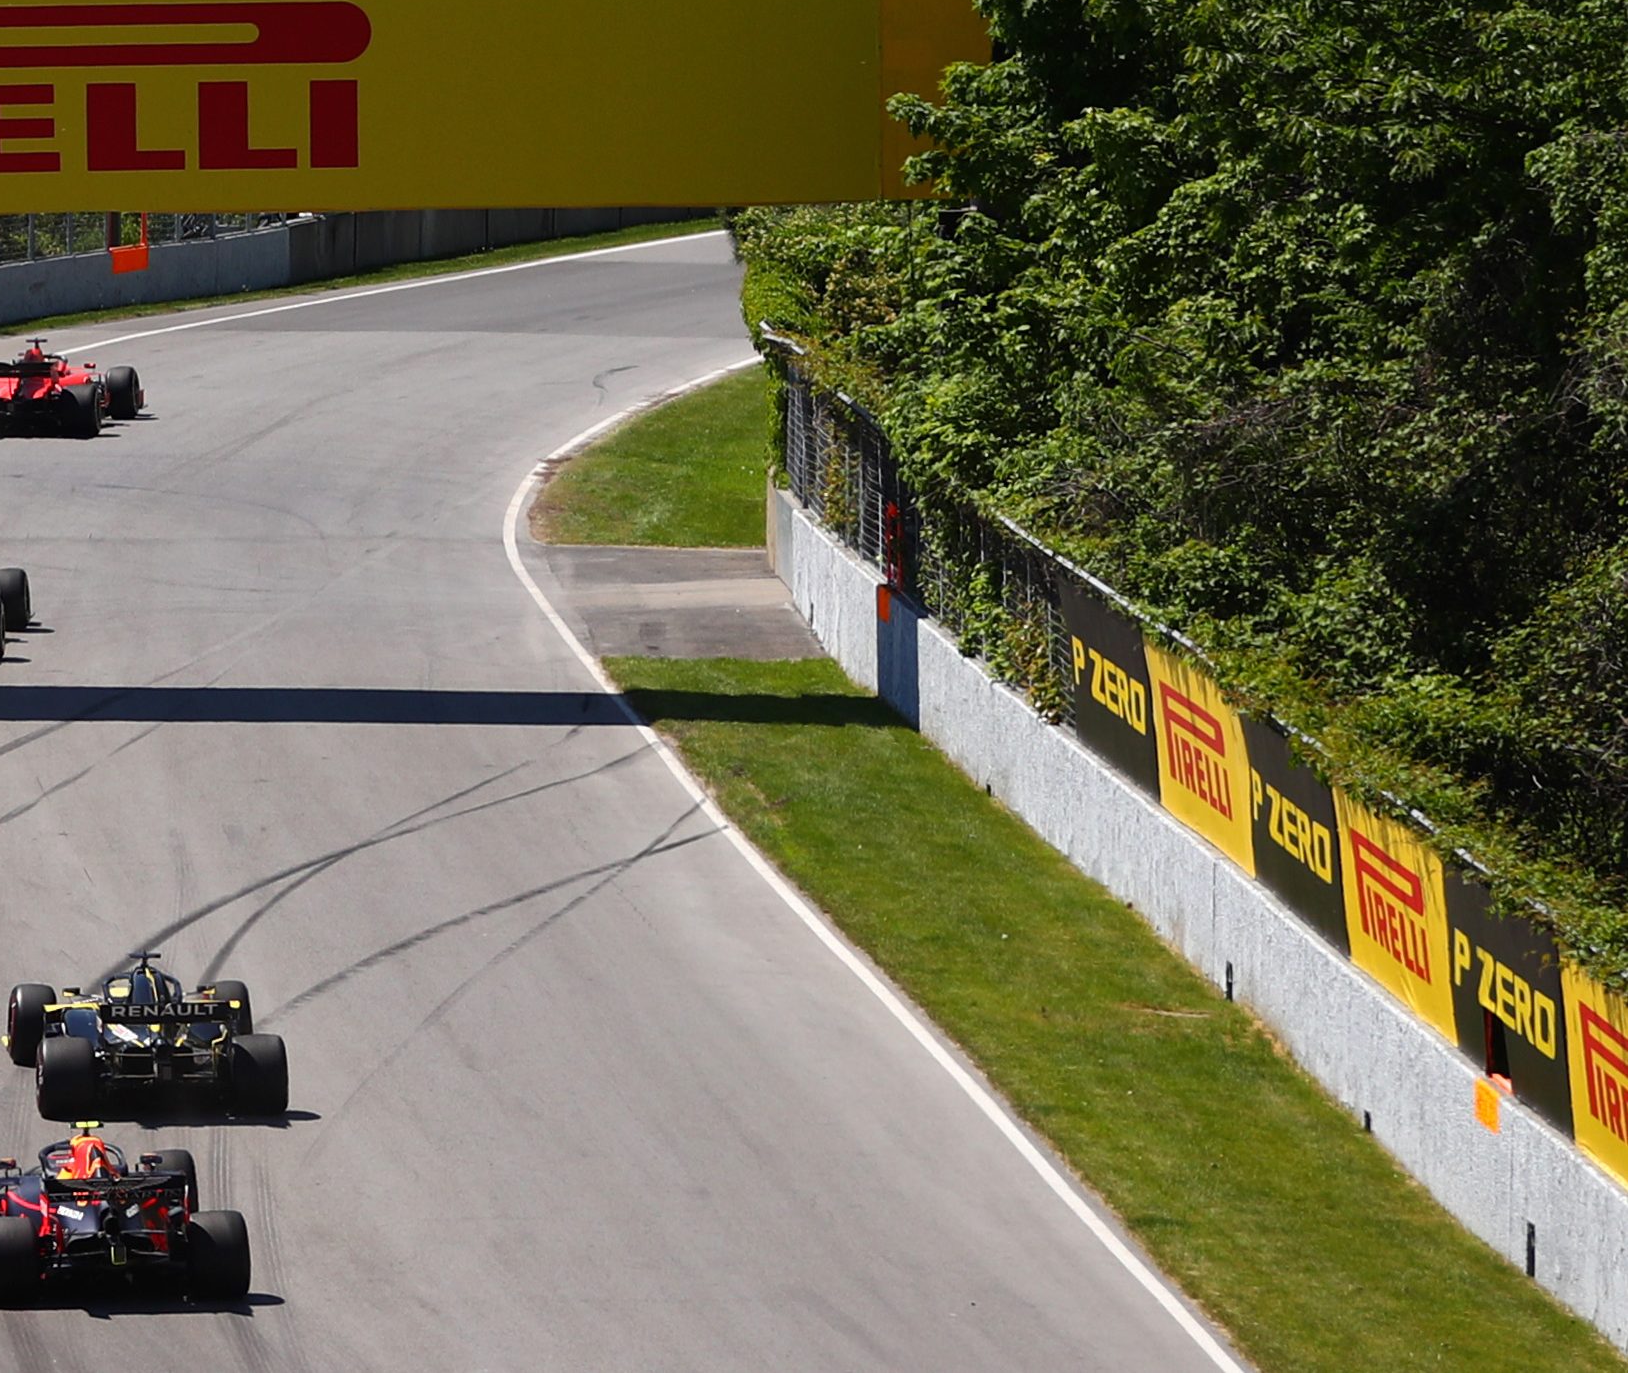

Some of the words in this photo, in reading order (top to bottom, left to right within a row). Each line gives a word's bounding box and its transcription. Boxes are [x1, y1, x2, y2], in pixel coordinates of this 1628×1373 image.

[1071, 635, 1086, 686] P
[1089, 647, 1146, 736] ZERO
[1158, 679, 1233, 821] PIRELLI
[1250, 766, 1263, 821] P
[1266, 783, 1332, 884] ZERO
[1350, 826, 1432, 986] PIRELLI
[110, 1003, 219, 1018] RENAULT
[1453, 927, 1472, 986] P
[1475, 945, 1556, 1060] ZERO
